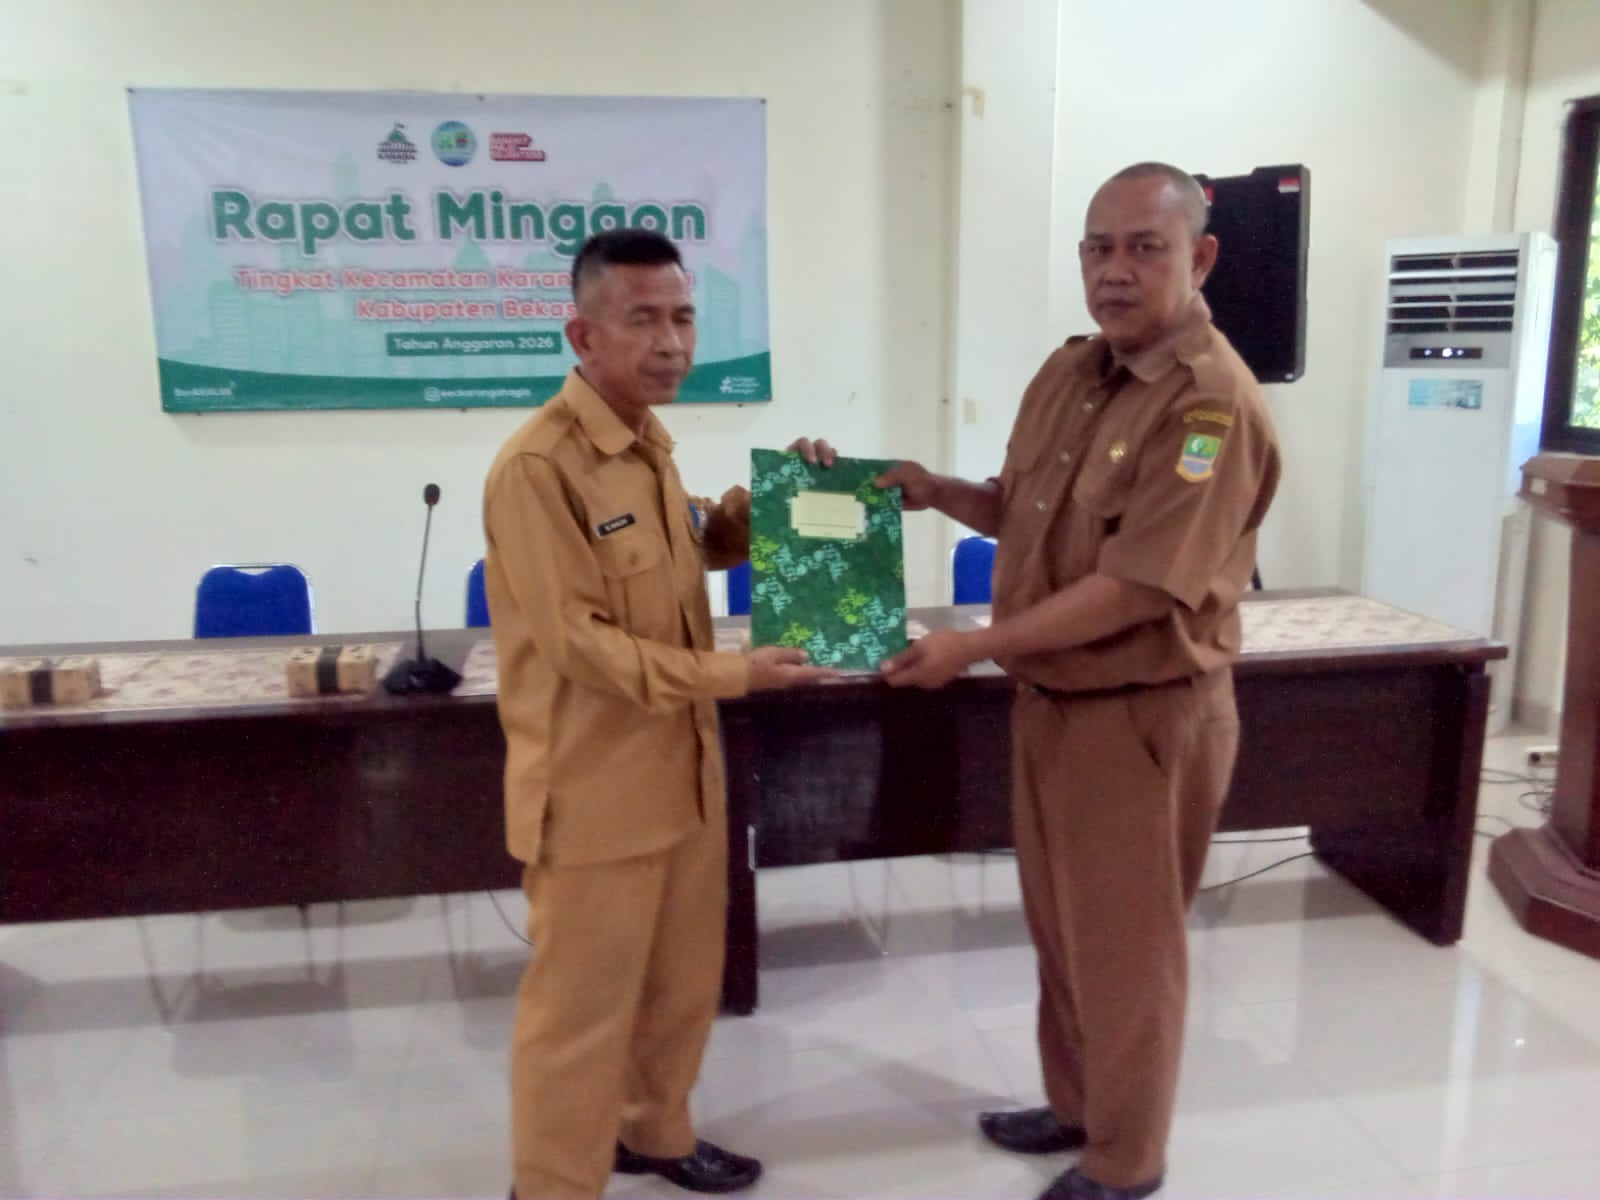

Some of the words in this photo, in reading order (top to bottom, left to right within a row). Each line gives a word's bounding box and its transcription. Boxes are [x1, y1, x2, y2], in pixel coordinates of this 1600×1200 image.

[212, 191, 416, 255] Rapat
[236, 268, 337, 294] Tingkat
[343, 269, 489, 288] Kecamatan
[357, 302, 497, 323] Kabupaten
[503, 300, 577, 320] Bekas
[394, 337, 438, 350] Tahun
[441, 337, 514, 353] Anggaran
[518, 337, 553, 349] 2026
